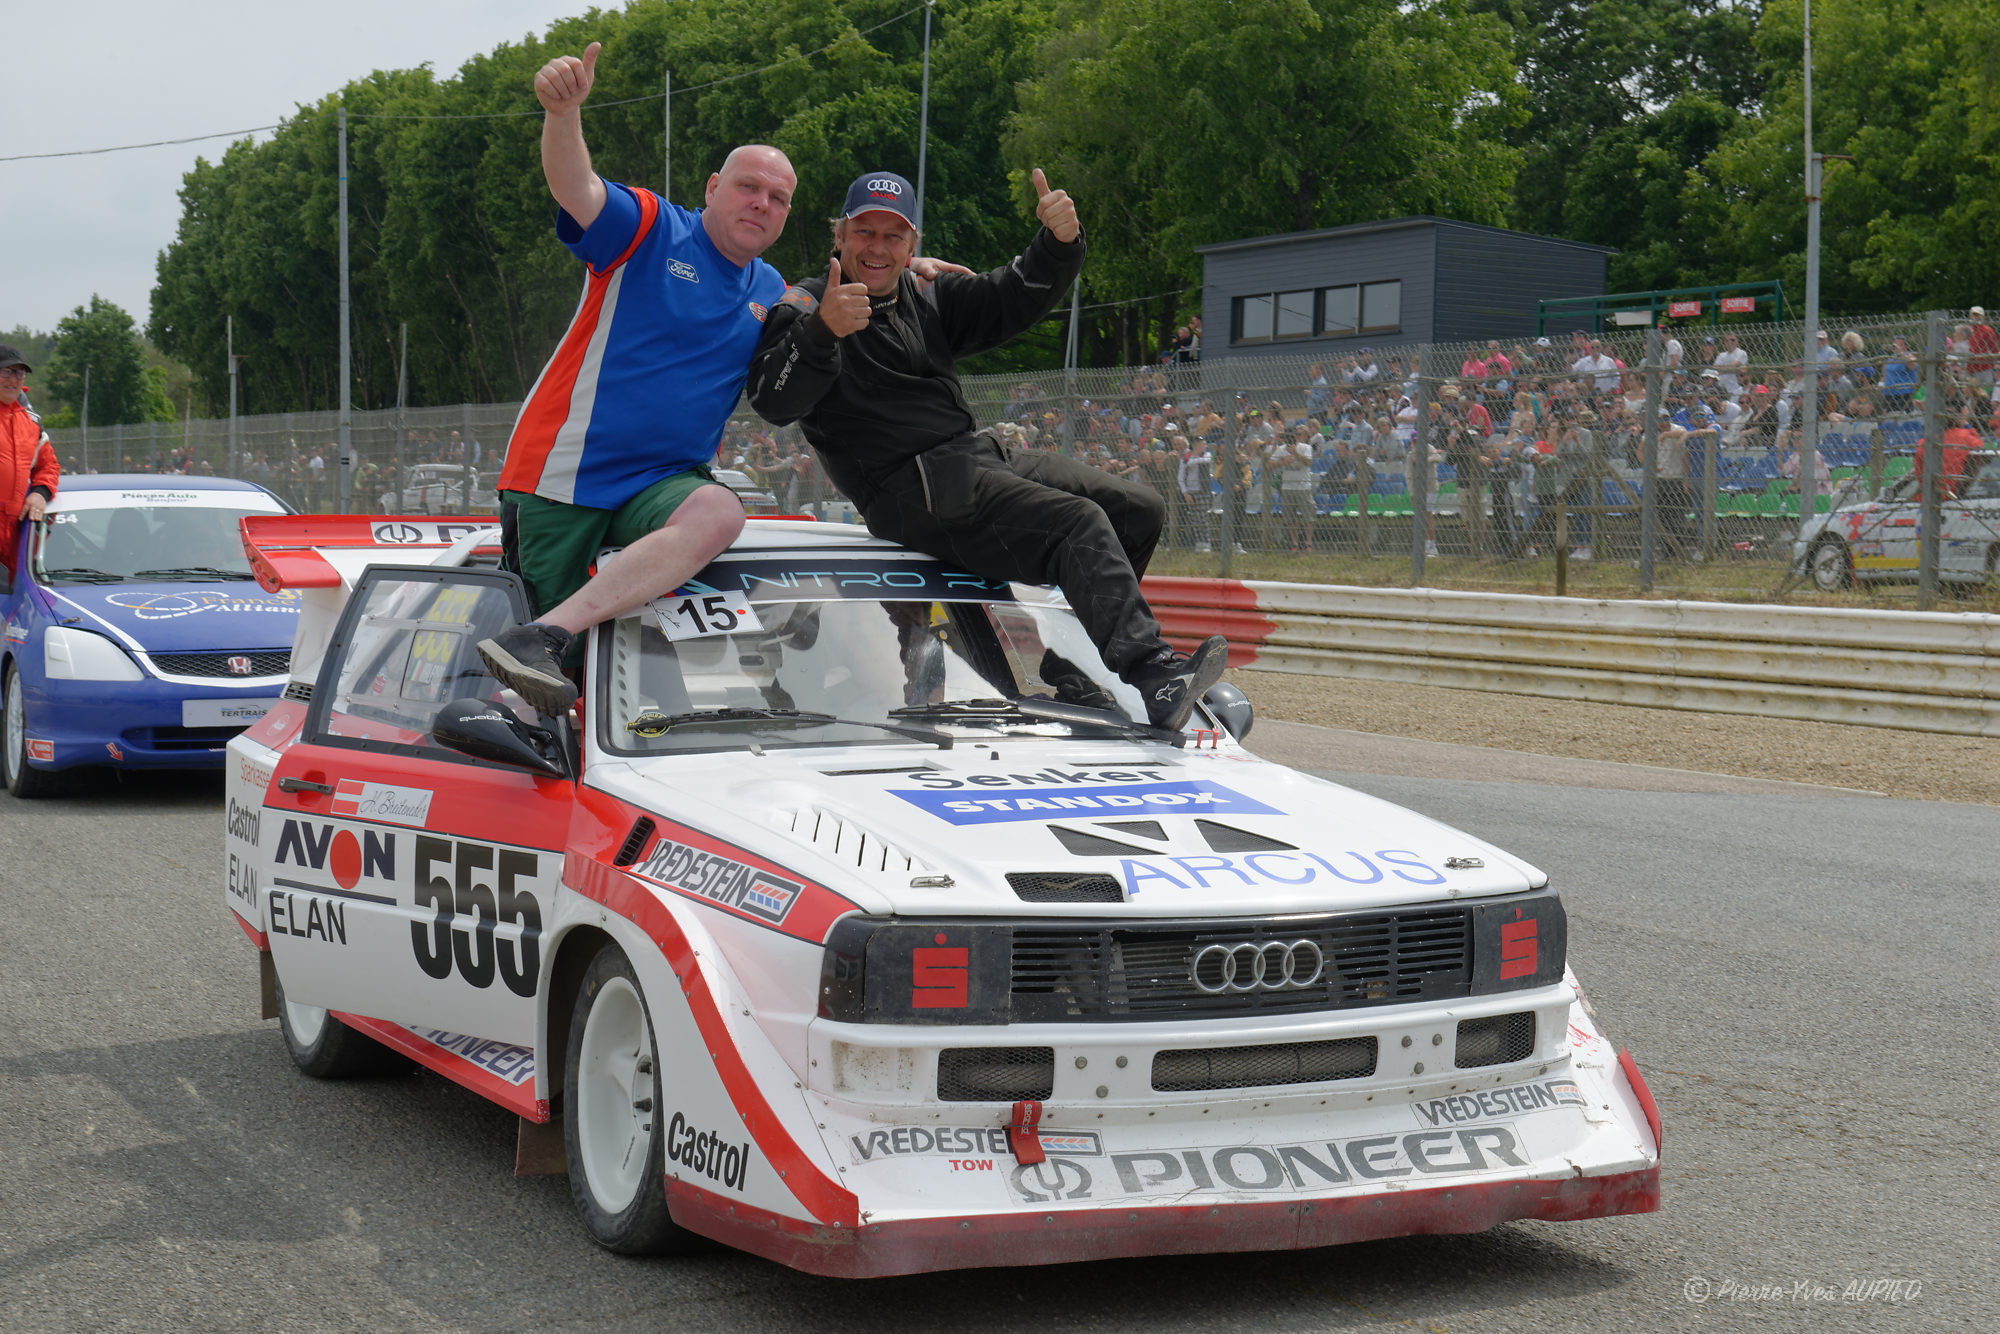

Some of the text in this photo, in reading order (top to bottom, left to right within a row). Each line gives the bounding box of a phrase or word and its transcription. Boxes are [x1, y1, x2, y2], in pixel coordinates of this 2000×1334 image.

[1674, 303, 1695, 313] SORTIE
[1726, 300, 1749, 309] SORTIE
[202, 597, 297, 606] France
[739, 571, 926, 590] NITRO
[677, 596, 739, 633] 15
[460, 714, 514, 725] quattro
[907, 767, 1168, 789] Senker
[228, 796, 262, 848] Castrol
[943, 792, 1233, 814] STANDOX
[275, 818, 396, 890] AVON
[638, 839, 752, 907] VREDESTEIN
[1120, 850, 1447, 895] ARCUS
[229, 853, 258, 909] ELAN
[269, 890, 347, 945] ELAN
[411, 834, 543, 998] 555
[1415, 1084, 1559, 1126] VREDESTEIN
[667, 1111, 750, 1192] Castrol
[949, 1160, 993, 1171] TOW
[1110, 1127, 1529, 1194] PIONEER
